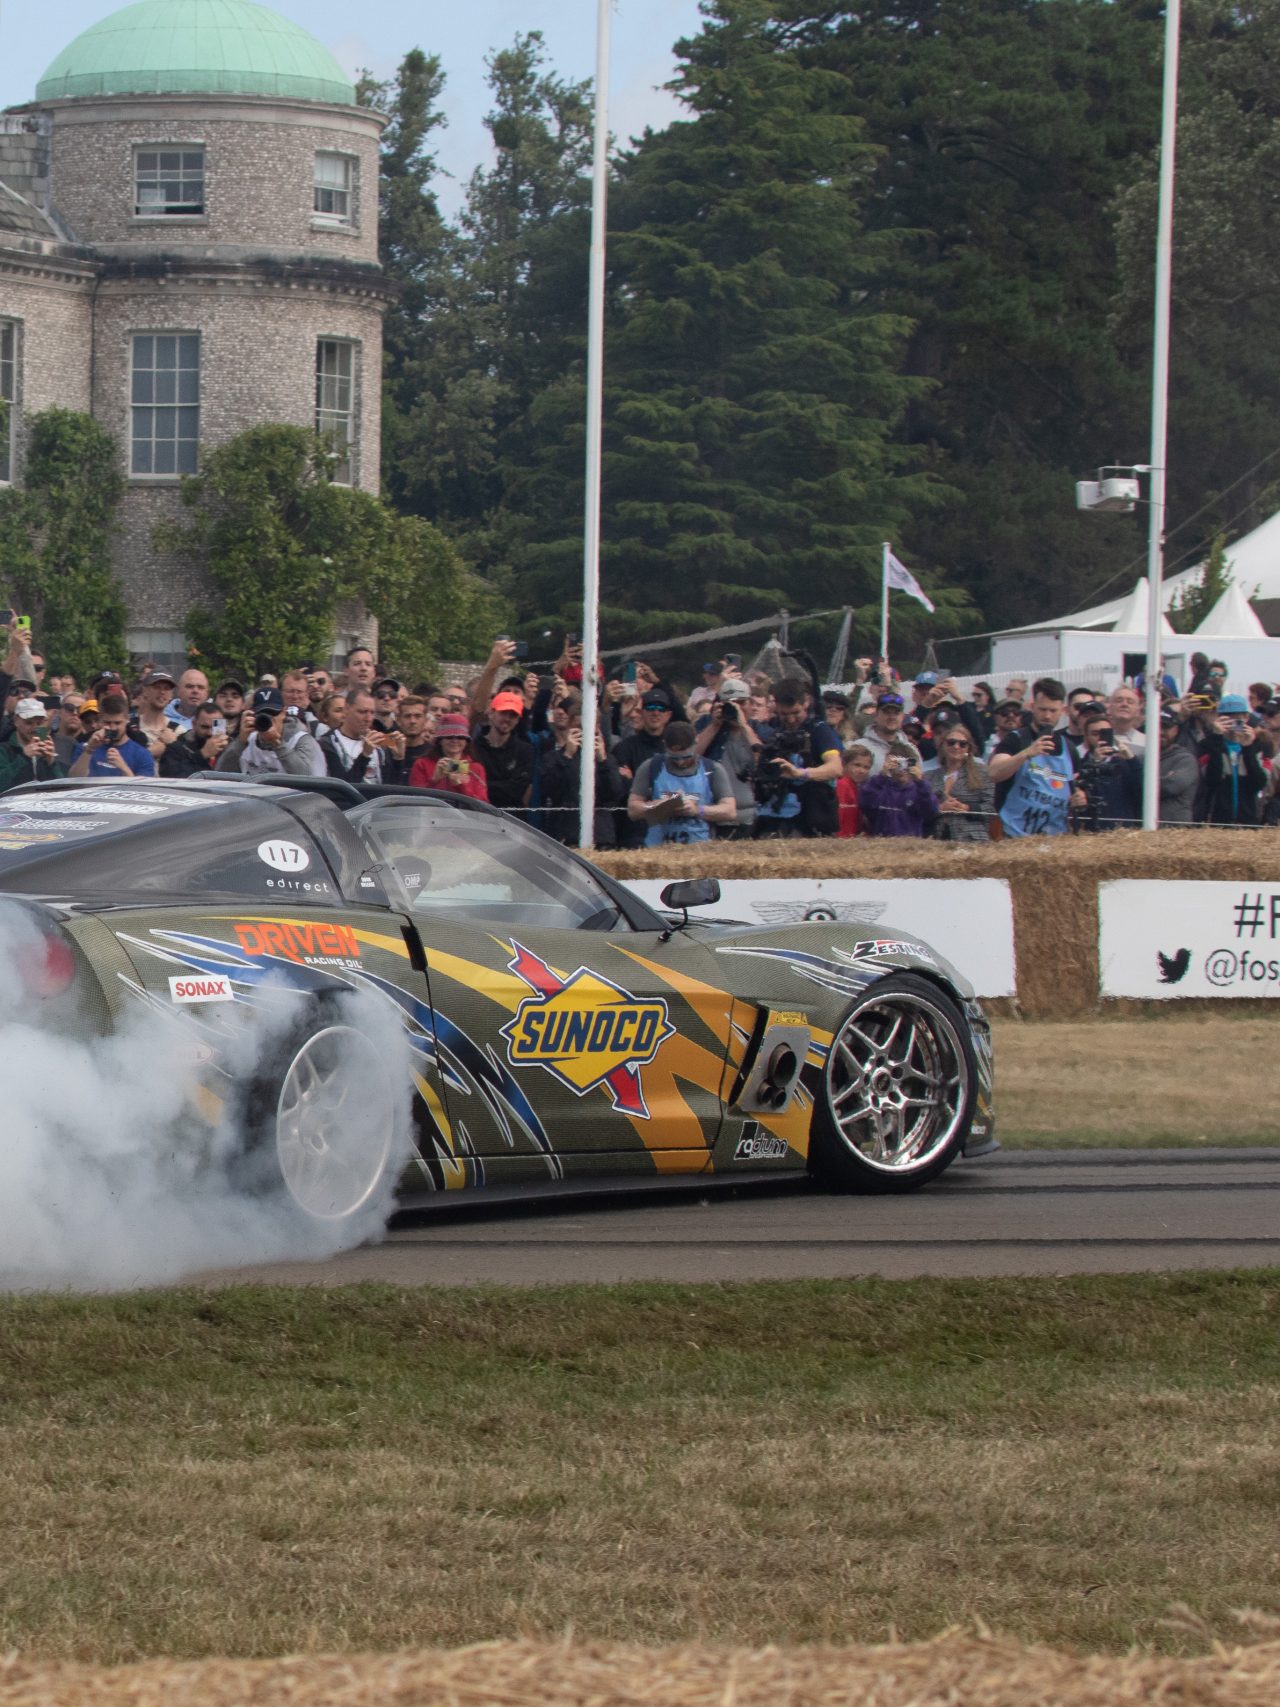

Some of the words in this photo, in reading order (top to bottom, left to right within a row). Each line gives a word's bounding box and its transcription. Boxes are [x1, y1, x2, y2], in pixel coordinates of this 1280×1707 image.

[268, 846, 299, 864] 117
[234, 923, 361, 965] DRIVEN
[303, 956, 346, 967] RACING
[345, 959, 363, 969] OIL
[175, 981, 226, 997] SONAX
[516, 1009, 661, 1054] SUNOCO
